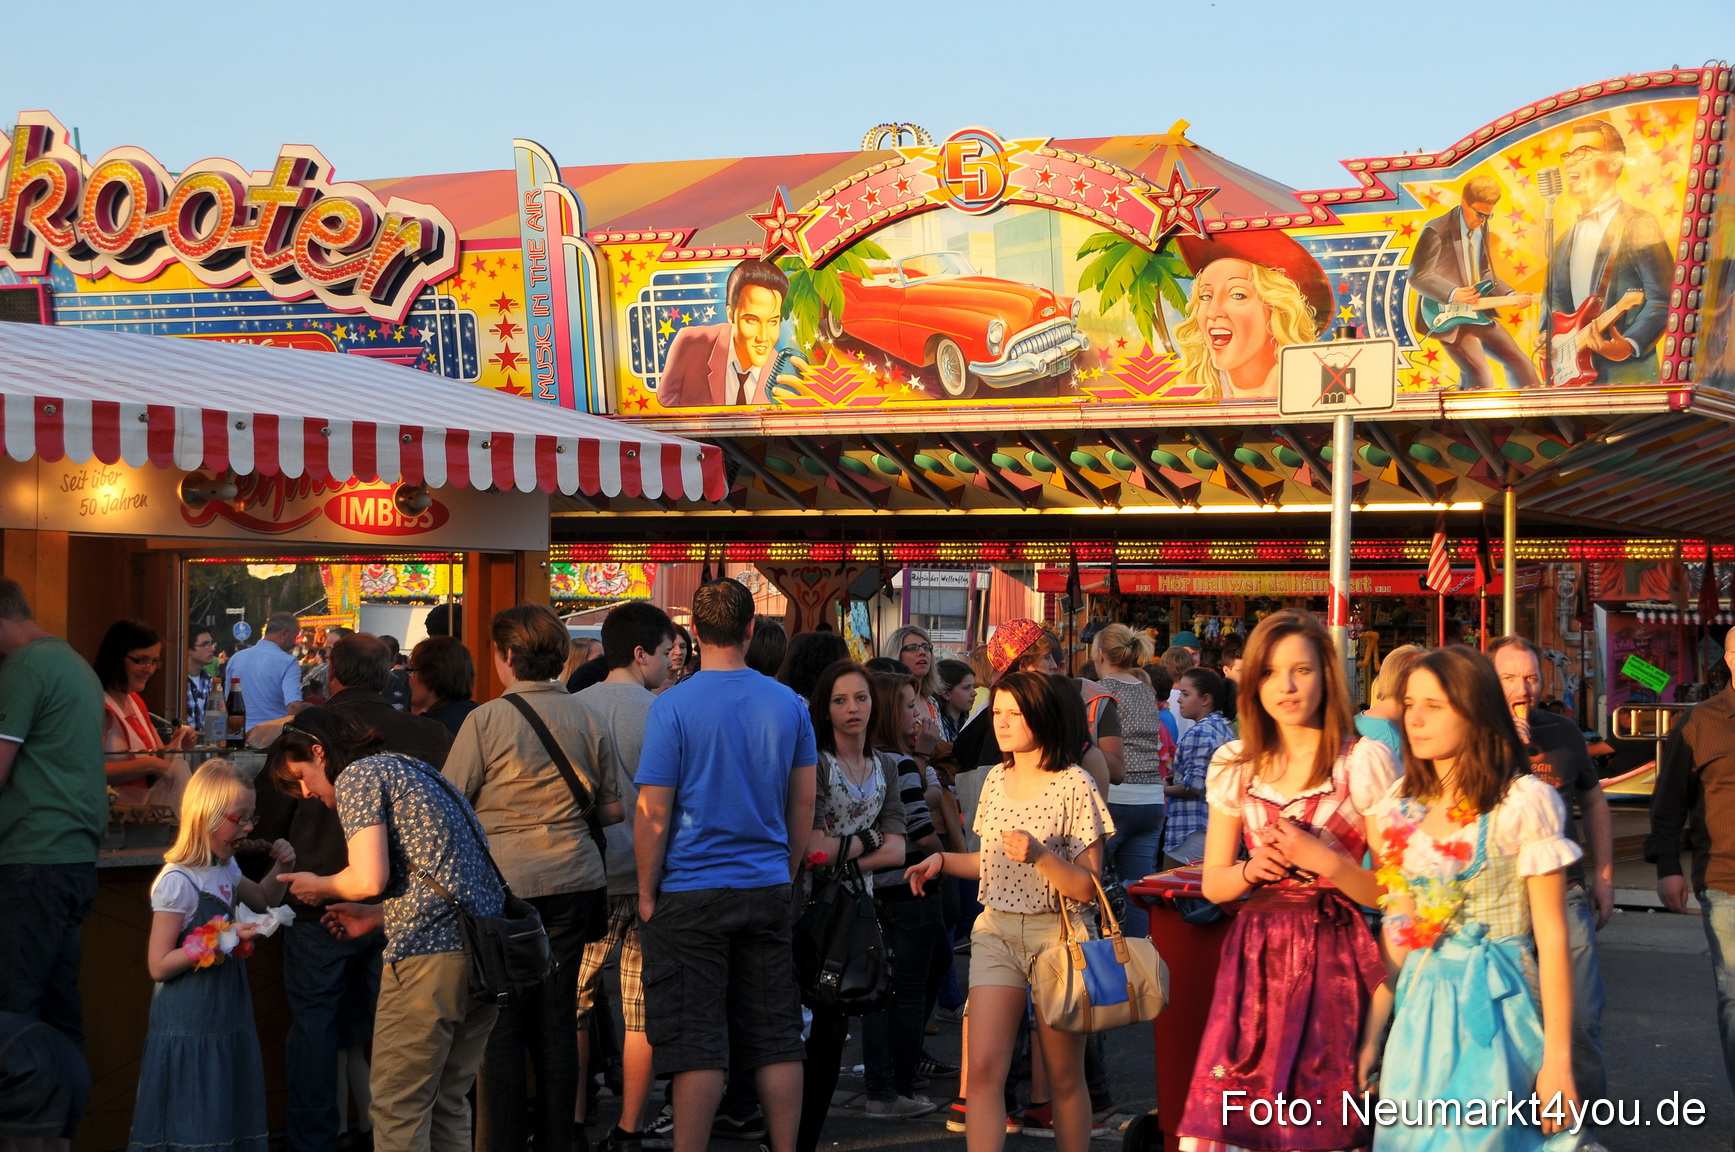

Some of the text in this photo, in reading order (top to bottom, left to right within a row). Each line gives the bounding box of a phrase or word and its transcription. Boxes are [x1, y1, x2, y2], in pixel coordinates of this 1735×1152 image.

[524, 188, 556, 400] MUSIC IN THE AIR
[60, 465, 123, 492] Seit über
[79, 488, 148, 516] 50 Jahren
[340, 496, 434, 529] IMBS
[1159, 574, 1190, 592] Hör
[1193, 575, 1225, 592] mal
[1228, 578, 1262, 592] wer
[1268, 575, 1288, 592] da
[1292, 574, 1371, 593] hämert
